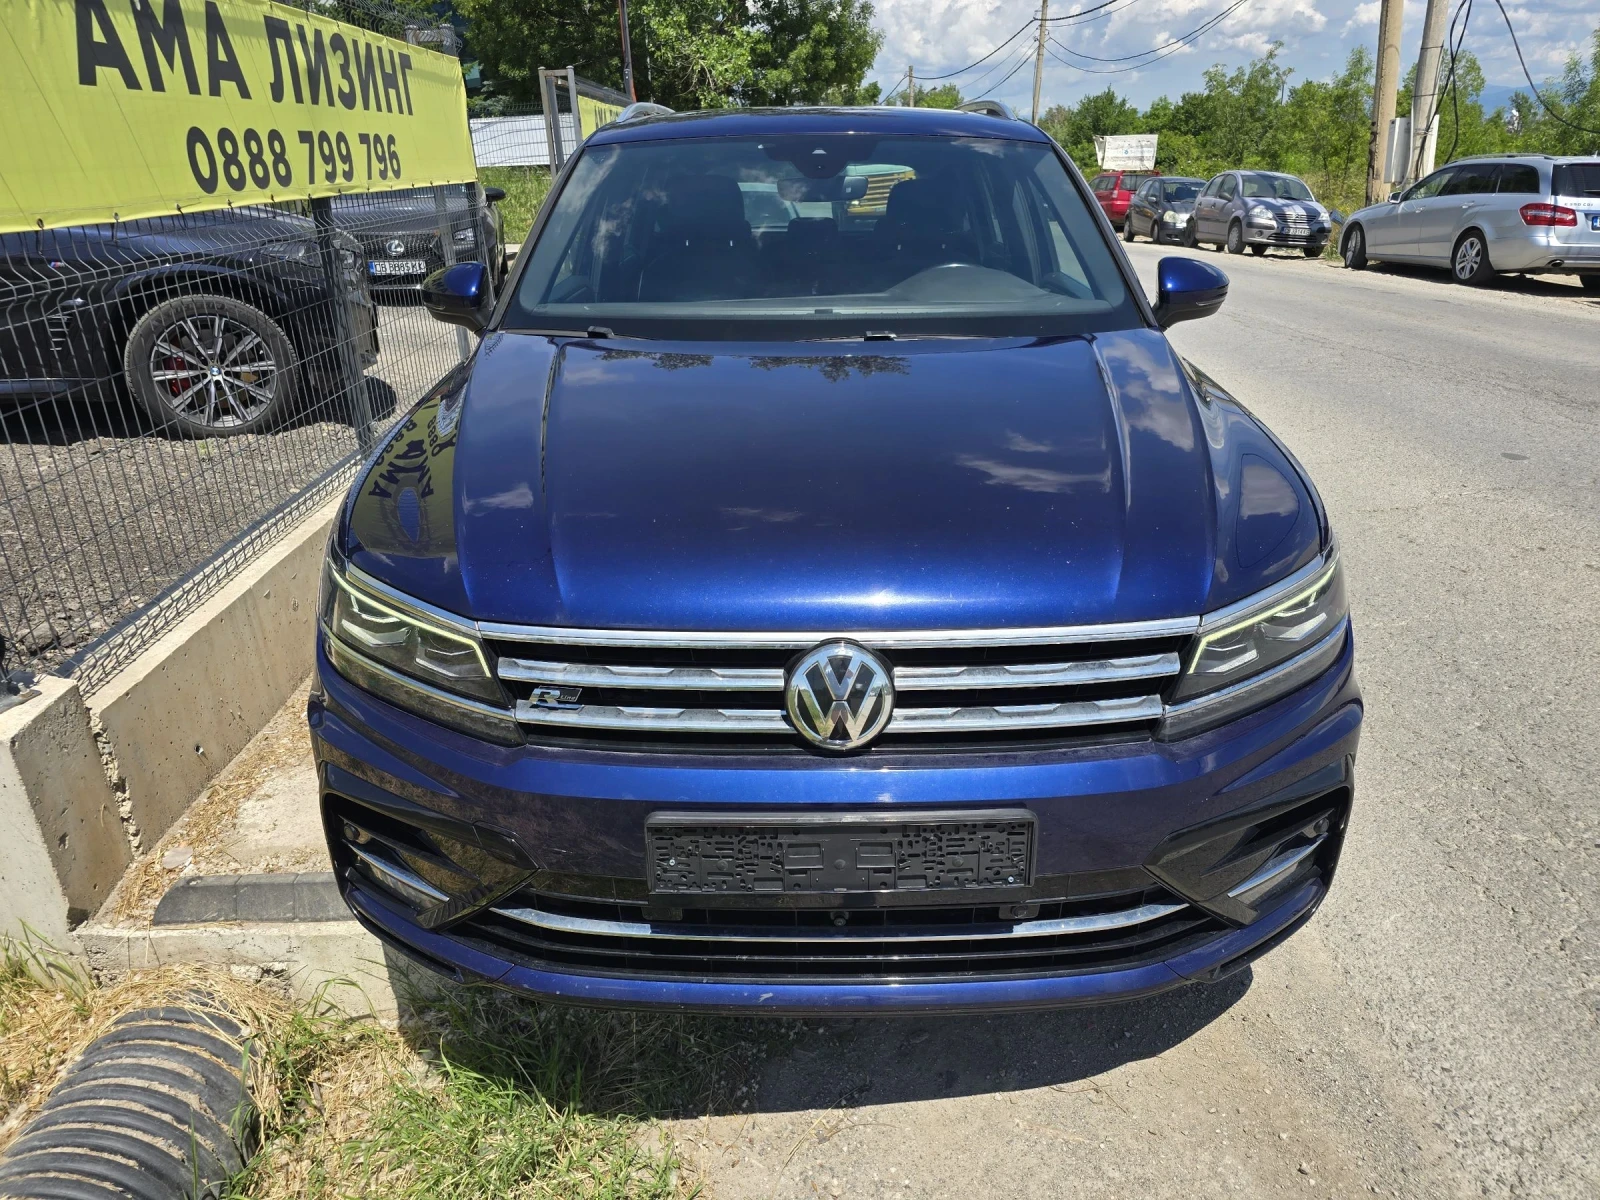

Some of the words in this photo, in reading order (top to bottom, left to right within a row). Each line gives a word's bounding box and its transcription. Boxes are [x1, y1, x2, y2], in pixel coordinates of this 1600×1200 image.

[75, 0, 253, 100] АМА
[263, 14, 413, 116] ЛИЗИНГ
[186, 126, 292, 194] 0888
[297, 130, 354, 185] 799
[358, 133, 401, 181] 796
[529, 687, 561, 705] R
